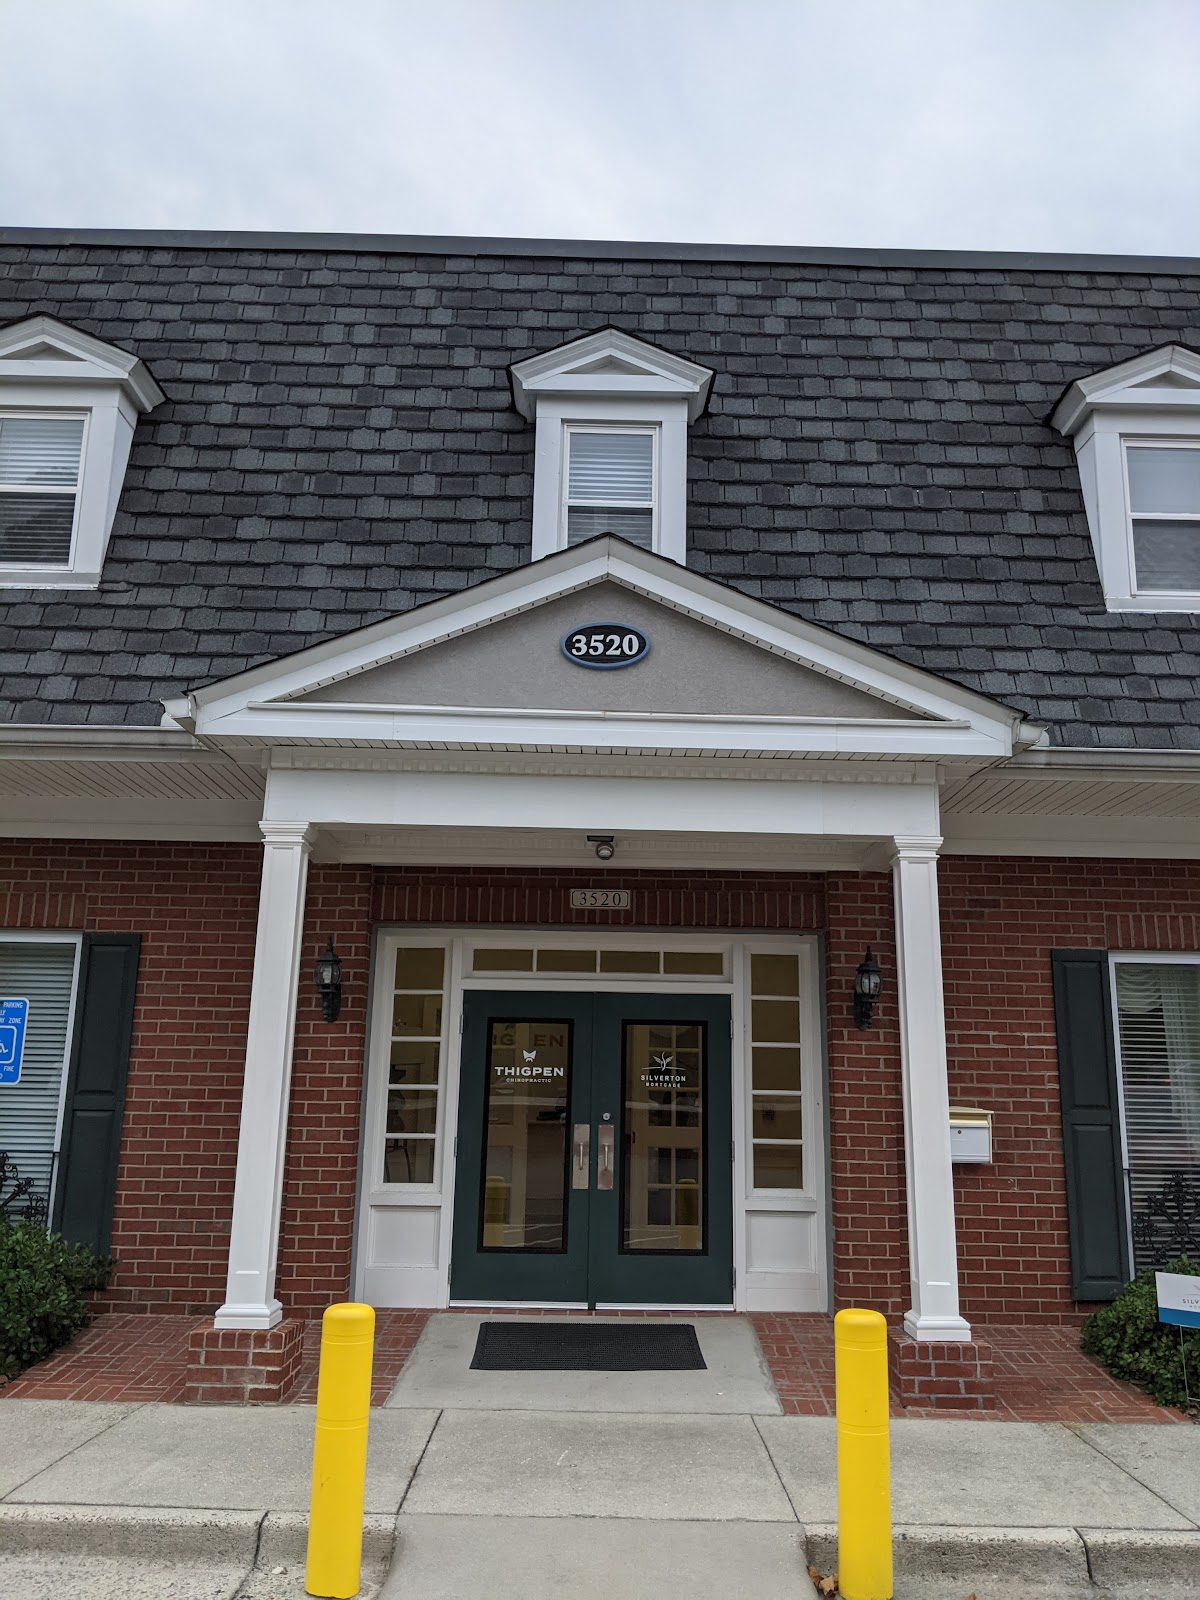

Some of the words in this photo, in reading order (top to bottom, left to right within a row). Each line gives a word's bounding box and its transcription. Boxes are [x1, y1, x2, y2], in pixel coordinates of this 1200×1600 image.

[571, 634, 640, 656] 3520
[579, 892, 621, 906] 3520
[494, 1066, 564, 1077] THIGPEN
[640, 1074, 686, 1082] SILVERTON
